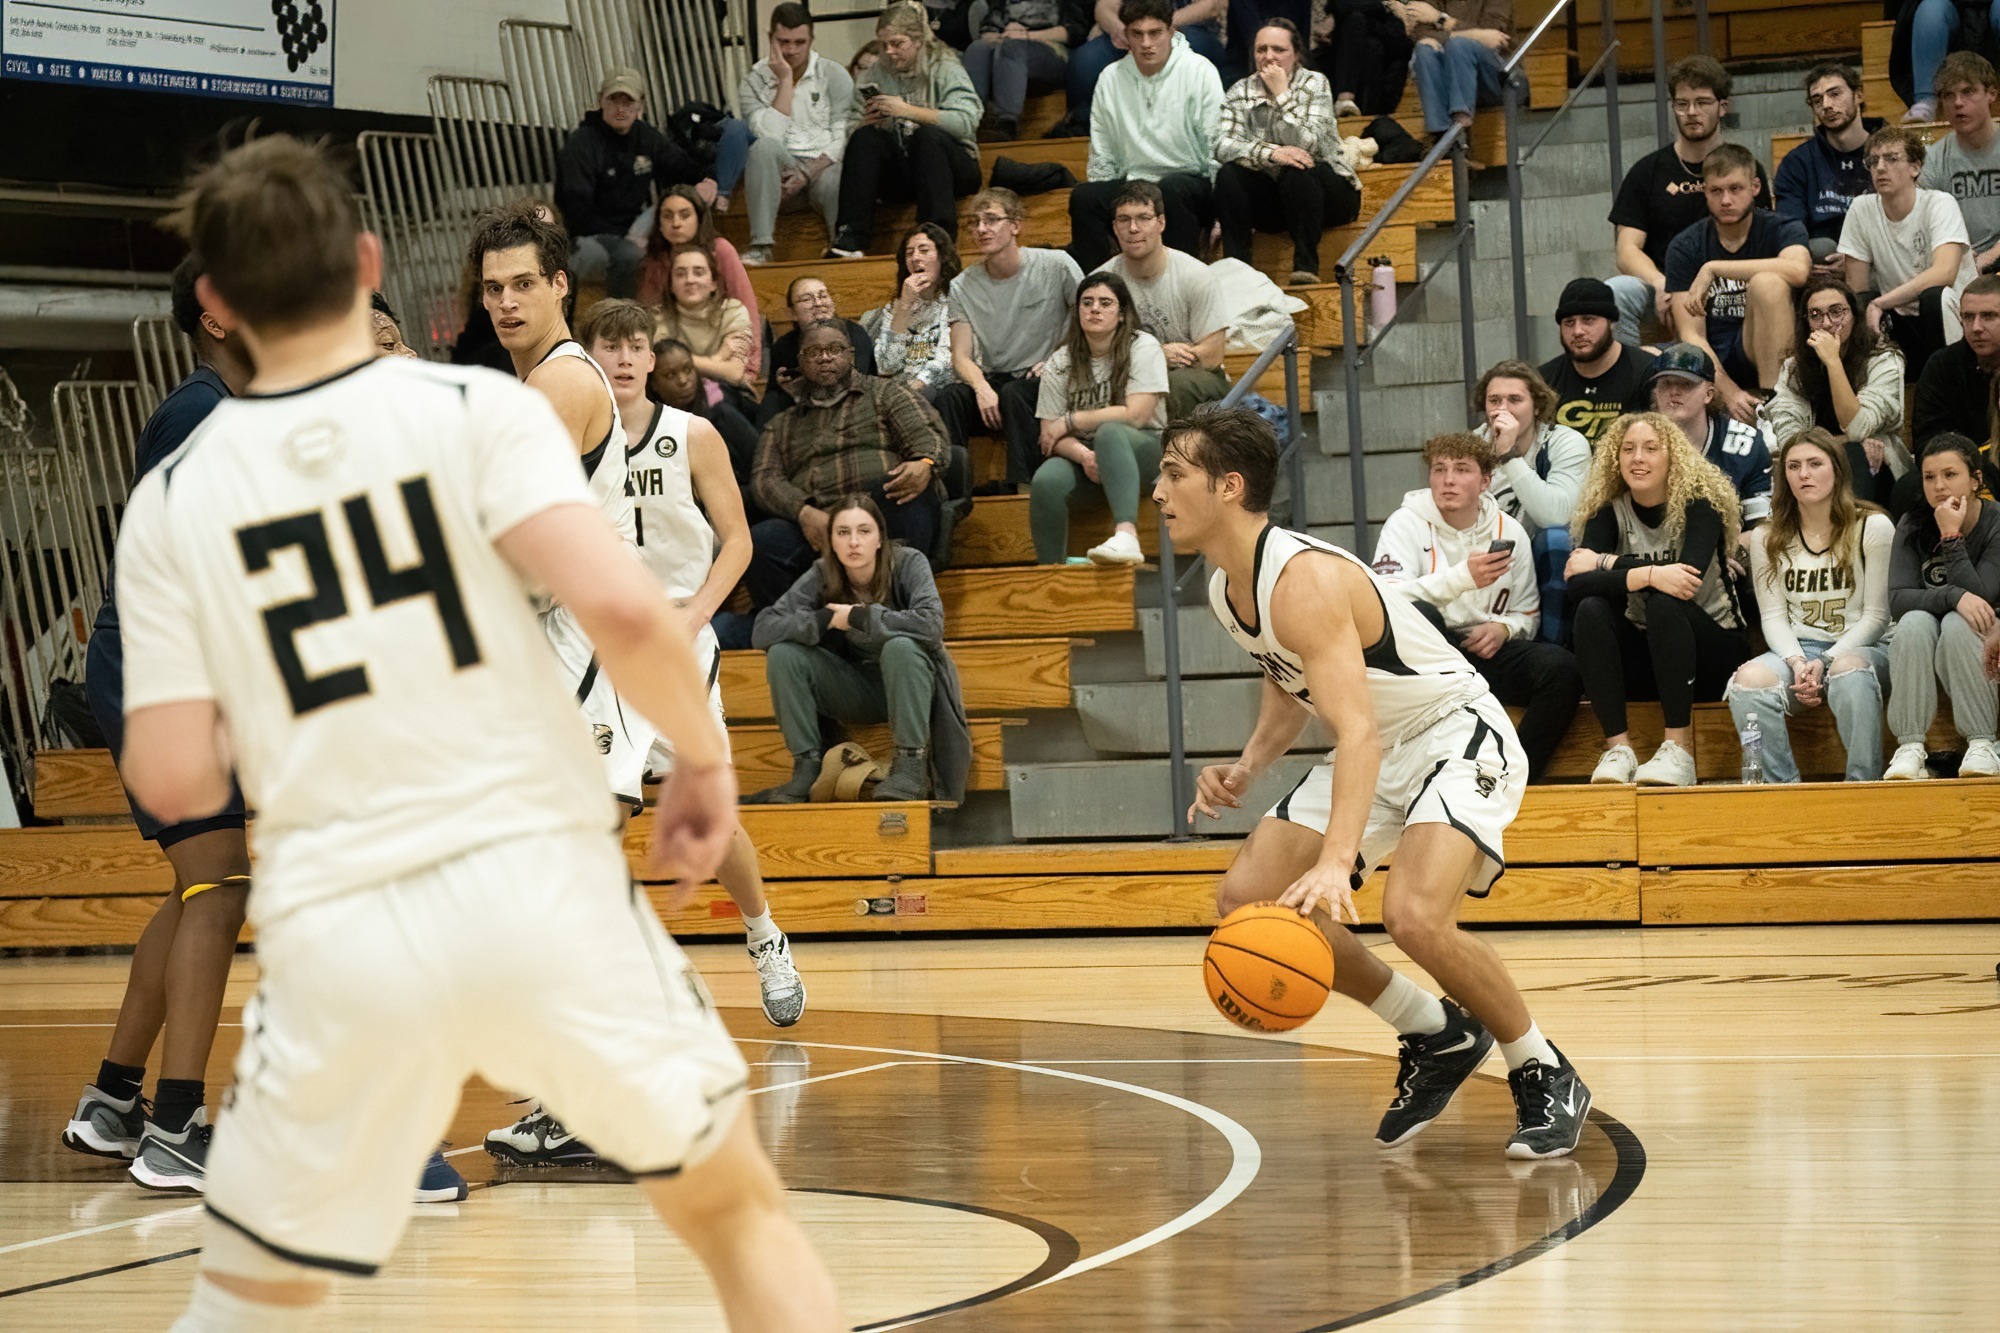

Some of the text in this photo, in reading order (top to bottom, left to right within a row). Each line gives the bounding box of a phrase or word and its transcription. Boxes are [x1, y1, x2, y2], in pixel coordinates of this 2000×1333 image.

[49, 64, 72, 78] SITE
[91, 67, 123, 82] WATER
[630, 467, 664, 497] VA
[233, 472, 487, 720] 24
[1800, 598, 1846, 633] 25
